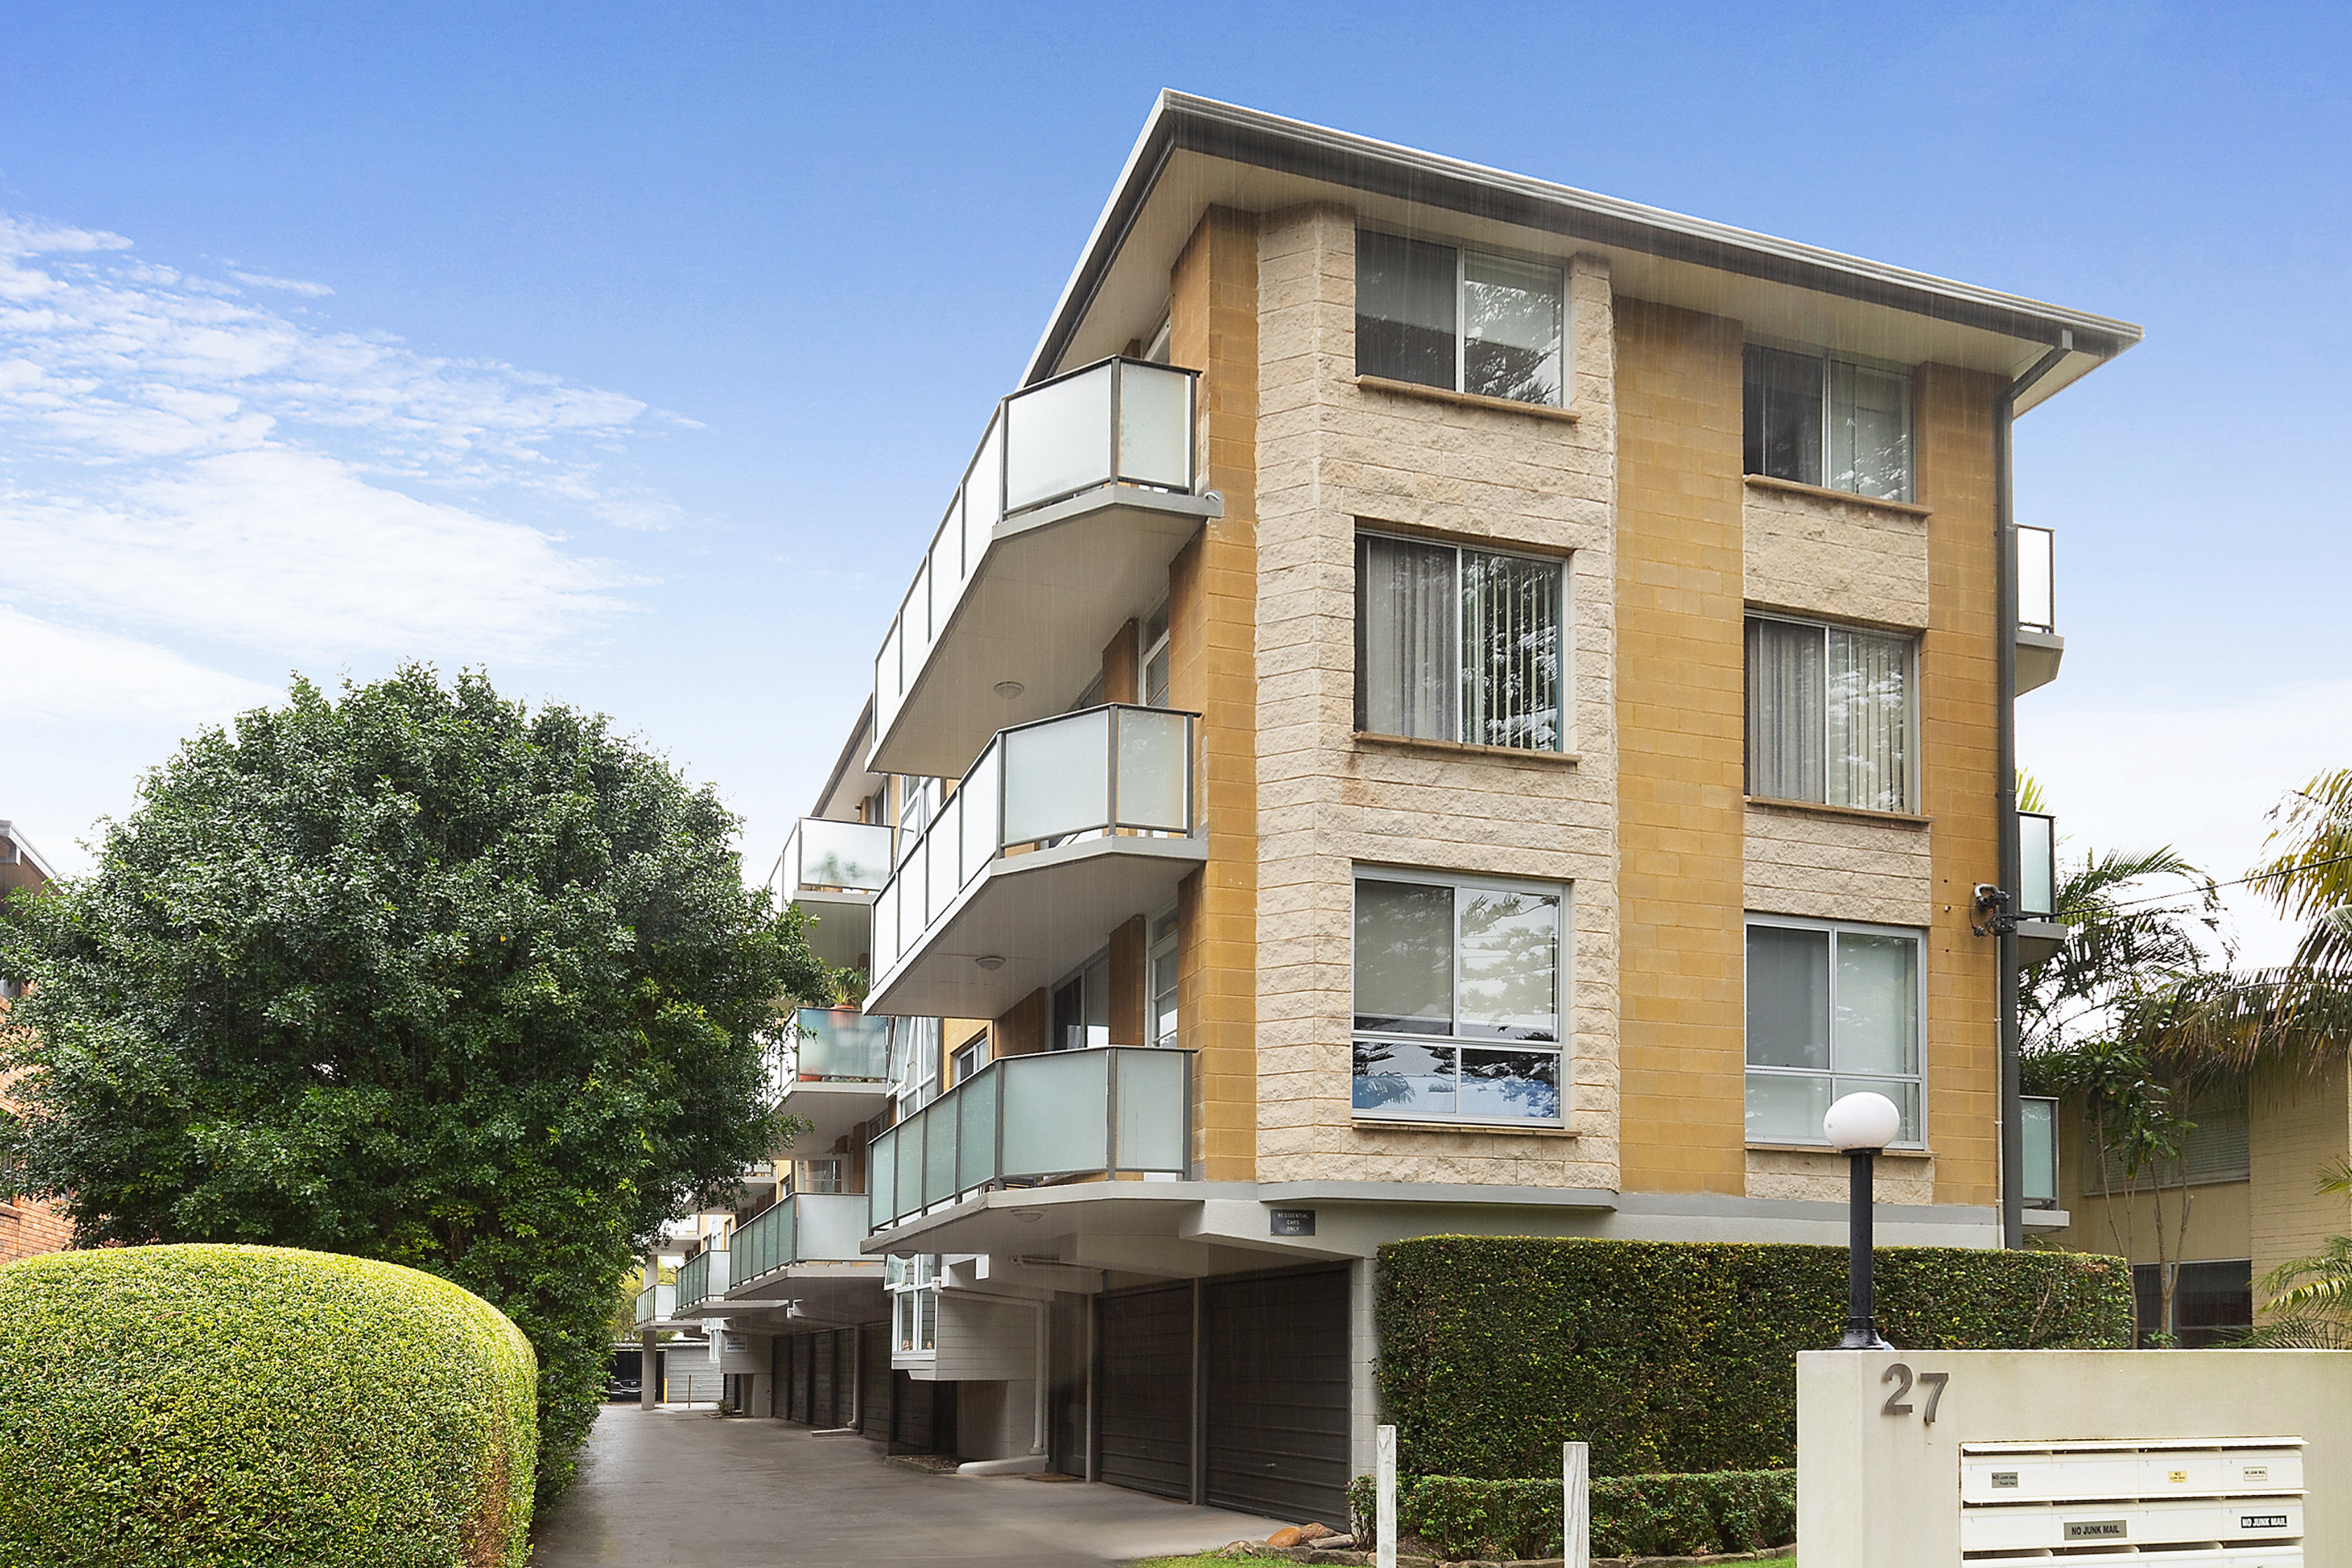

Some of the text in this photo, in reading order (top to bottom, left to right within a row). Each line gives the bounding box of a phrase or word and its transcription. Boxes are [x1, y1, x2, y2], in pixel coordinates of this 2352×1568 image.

[1881, 1363, 1949, 1426] 27
[2242, 1517, 2287, 1527] NO JUNK MAIL
[2072, 1525, 2120, 1535] NO JUNK MAIL
